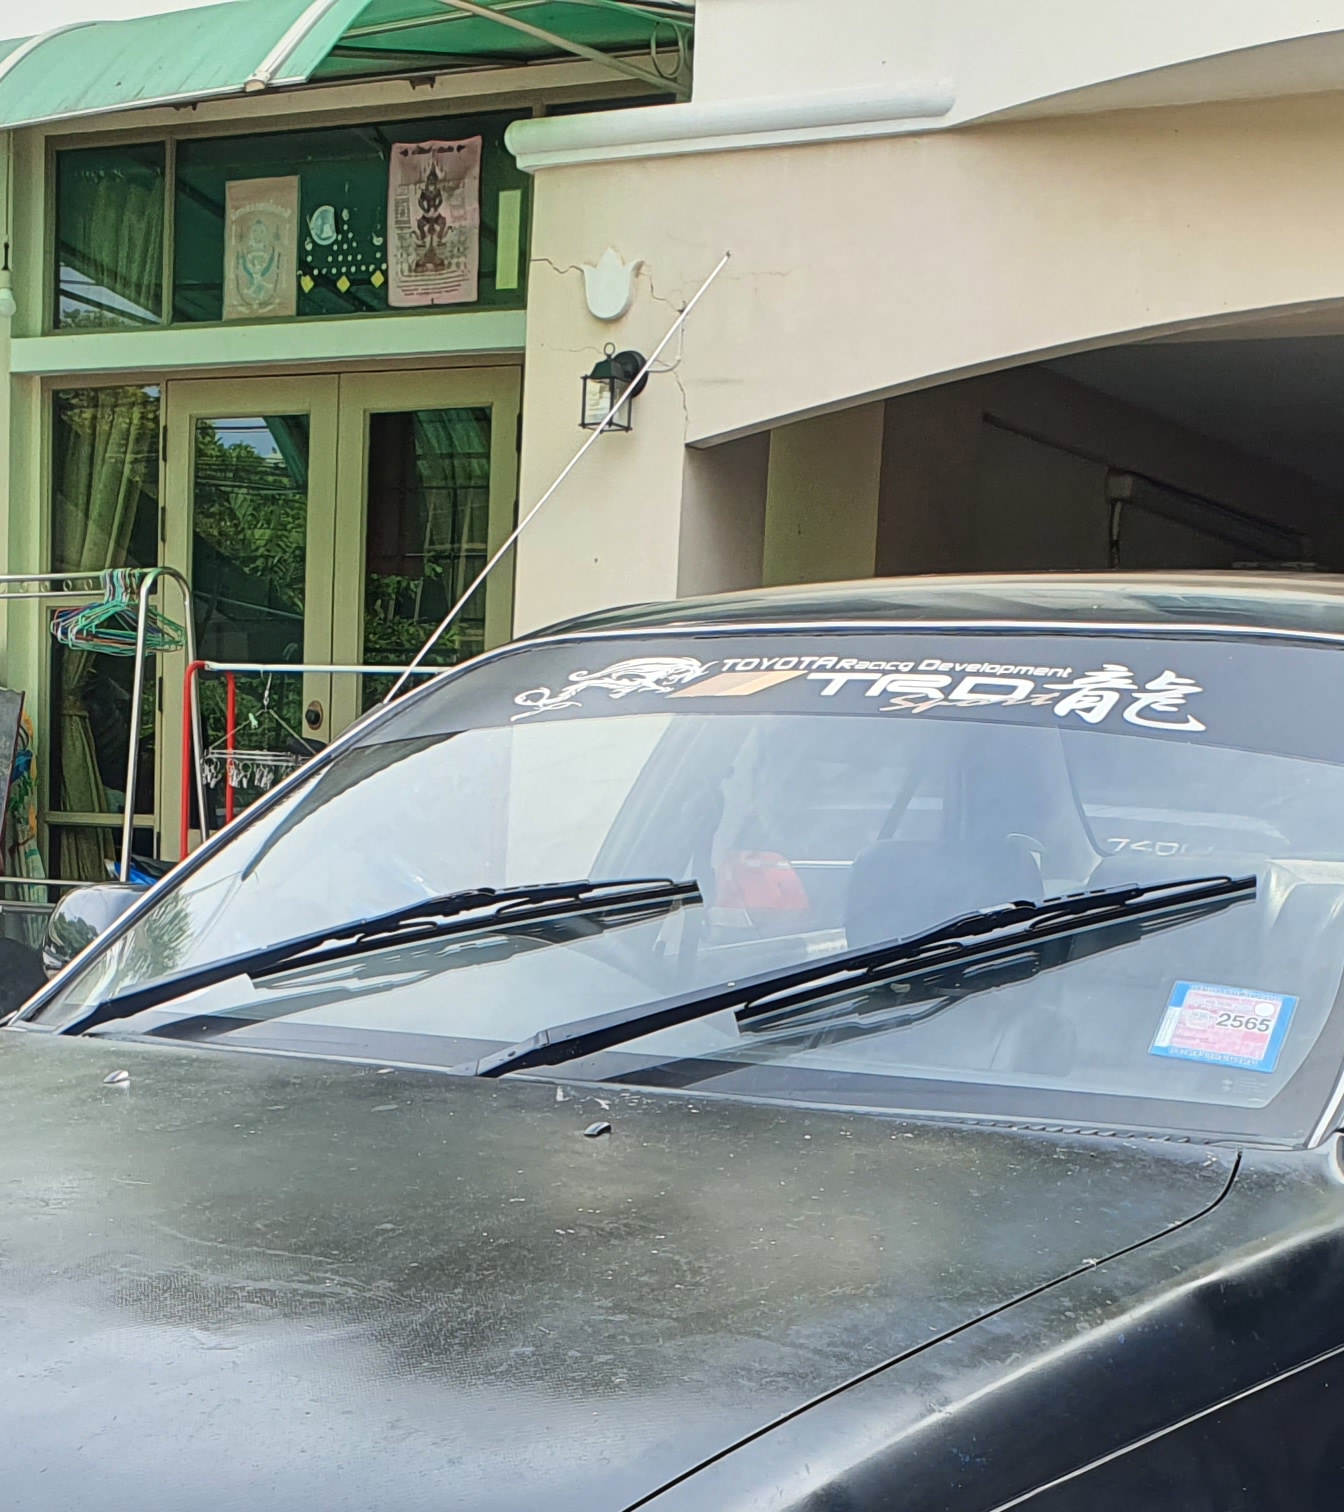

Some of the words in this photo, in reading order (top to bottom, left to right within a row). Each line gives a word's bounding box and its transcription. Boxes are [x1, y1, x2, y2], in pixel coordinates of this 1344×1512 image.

[722, 656, 838, 671] TOYOTA
[917, 659, 1073, 678] Development
[807, 672, 1035, 700] TRD
[1216, 1012, 1272, 1033] 2565
